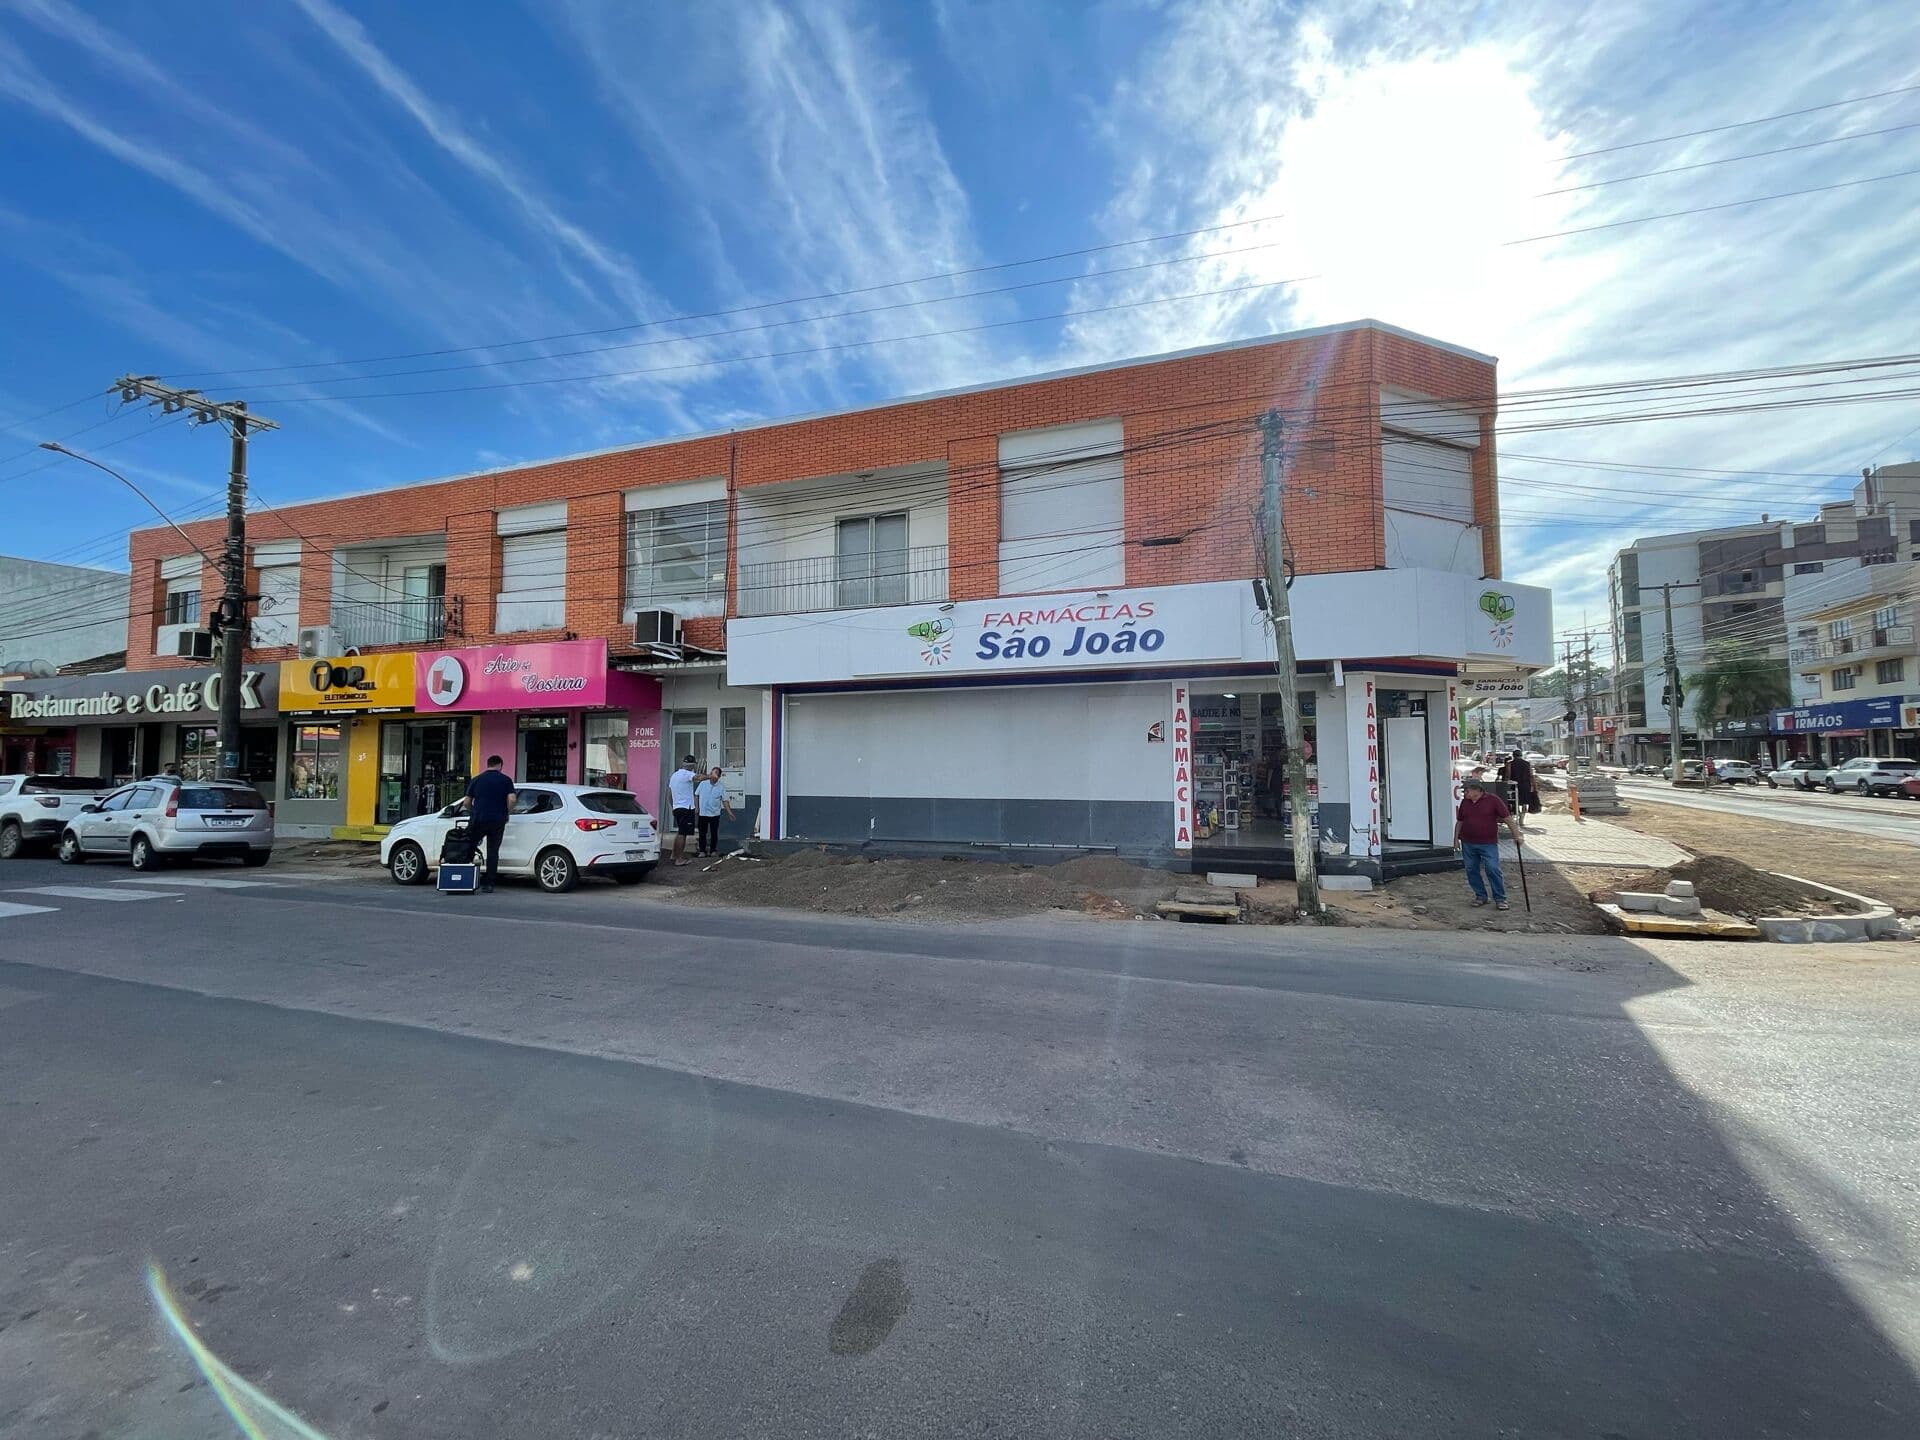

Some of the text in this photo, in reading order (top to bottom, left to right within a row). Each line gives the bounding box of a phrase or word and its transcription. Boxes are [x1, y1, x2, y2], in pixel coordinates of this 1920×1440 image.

[983, 602, 1154, 628] FARMÁCIAS
[976, 621, 1165, 660] São João
[484, 654, 519, 674] Arte
[522, 673, 587, 693] Costura
[10, 691, 122, 718] Restaurante
[126, 694, 142, 714] e
[145, 682, 198, 713] Café
[1794, 709, 1810, 719] DOS
[1795, 714, 1843, 729] IRMÃOS
[635, 727, 655, 736] FONE
[1174, 688, 1191, 843] FARMÁCIA
[1366, 681, 1380, 846] FARMÁCIA
